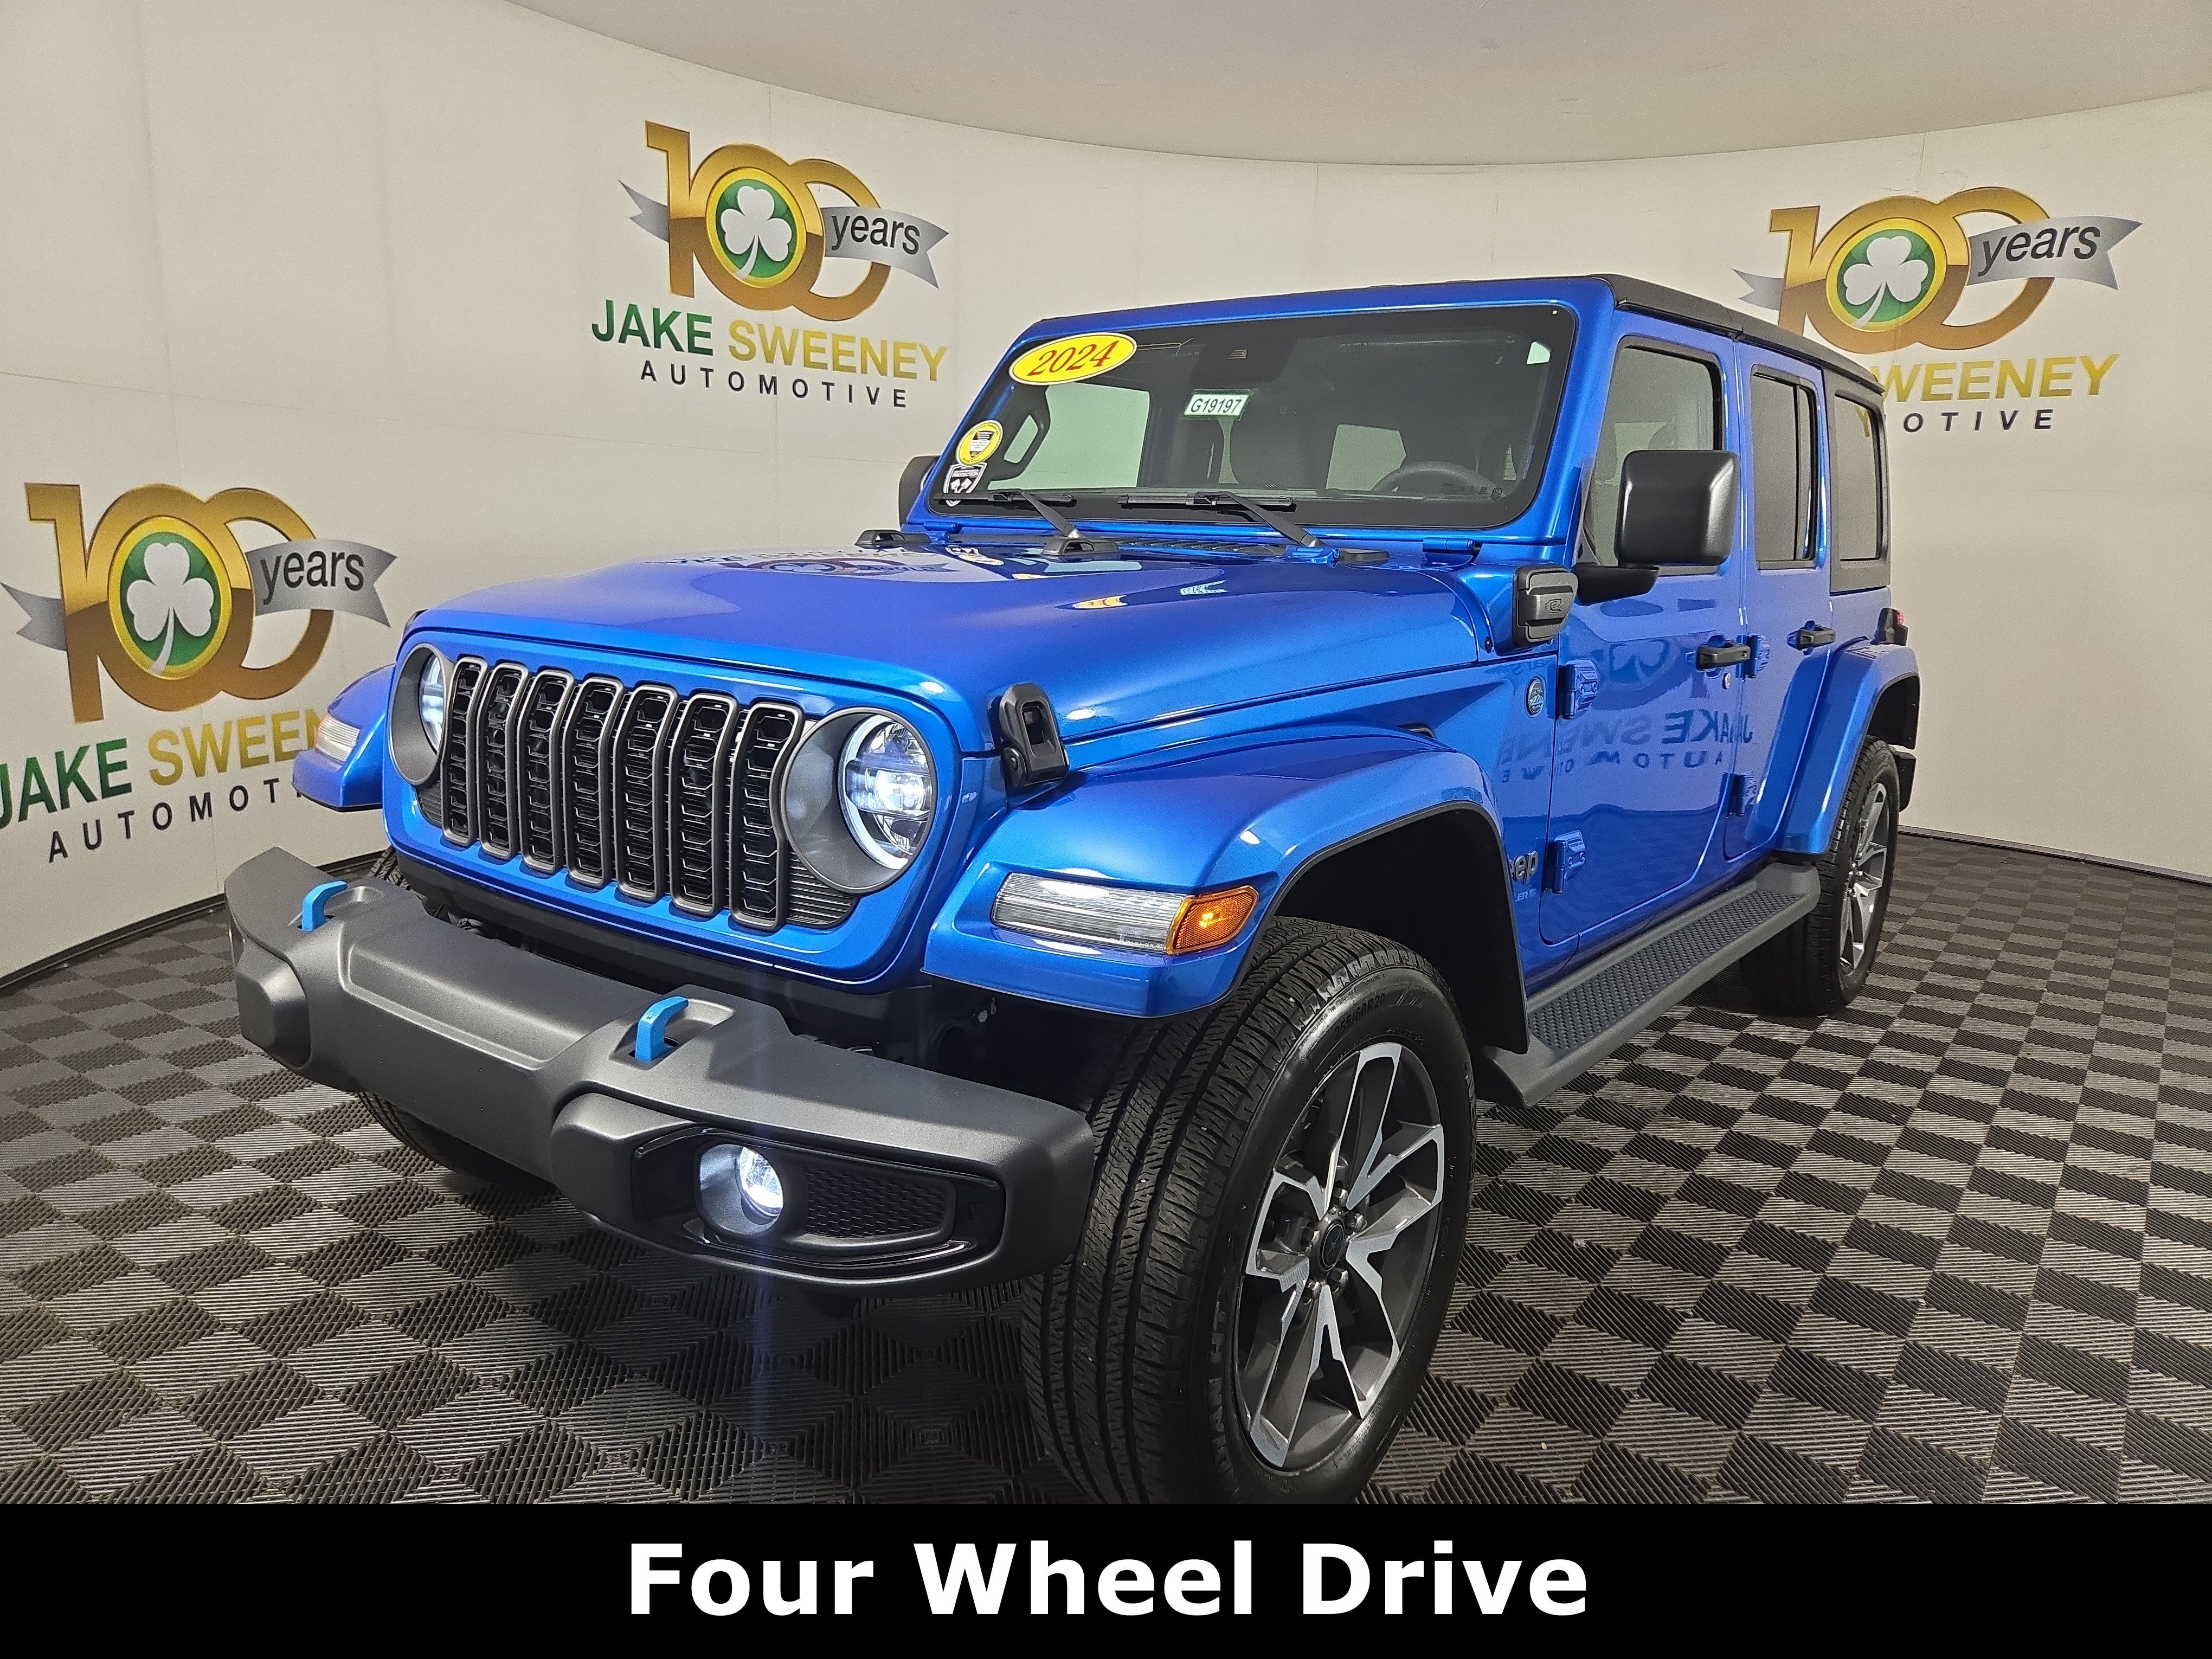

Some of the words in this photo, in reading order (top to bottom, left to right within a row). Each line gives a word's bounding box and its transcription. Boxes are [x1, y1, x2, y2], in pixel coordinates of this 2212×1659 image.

[645, 120, 891, 321] 100
[832, 214, 921, 255] years
[1769, 187, 2055, 355] 100
[1977, 224, 2101, 278] years
[591, 299, 713, 356] JAKE
[728, 320, 948, 382] SWEENEY
[1026, 339, 1120, 377] 2024
[640, 360, 906, 408] AUTOMOTIVE
[1191, 397, 1244, 415] G19197
[1885, 409, 2054, 433] OTIVE
[24, 483, 334, 723] 100
[260, 550, 364, 605] years
[0, 737, 133, 829] JAKE
[49, 777, 301, 864] AUTOMOT
